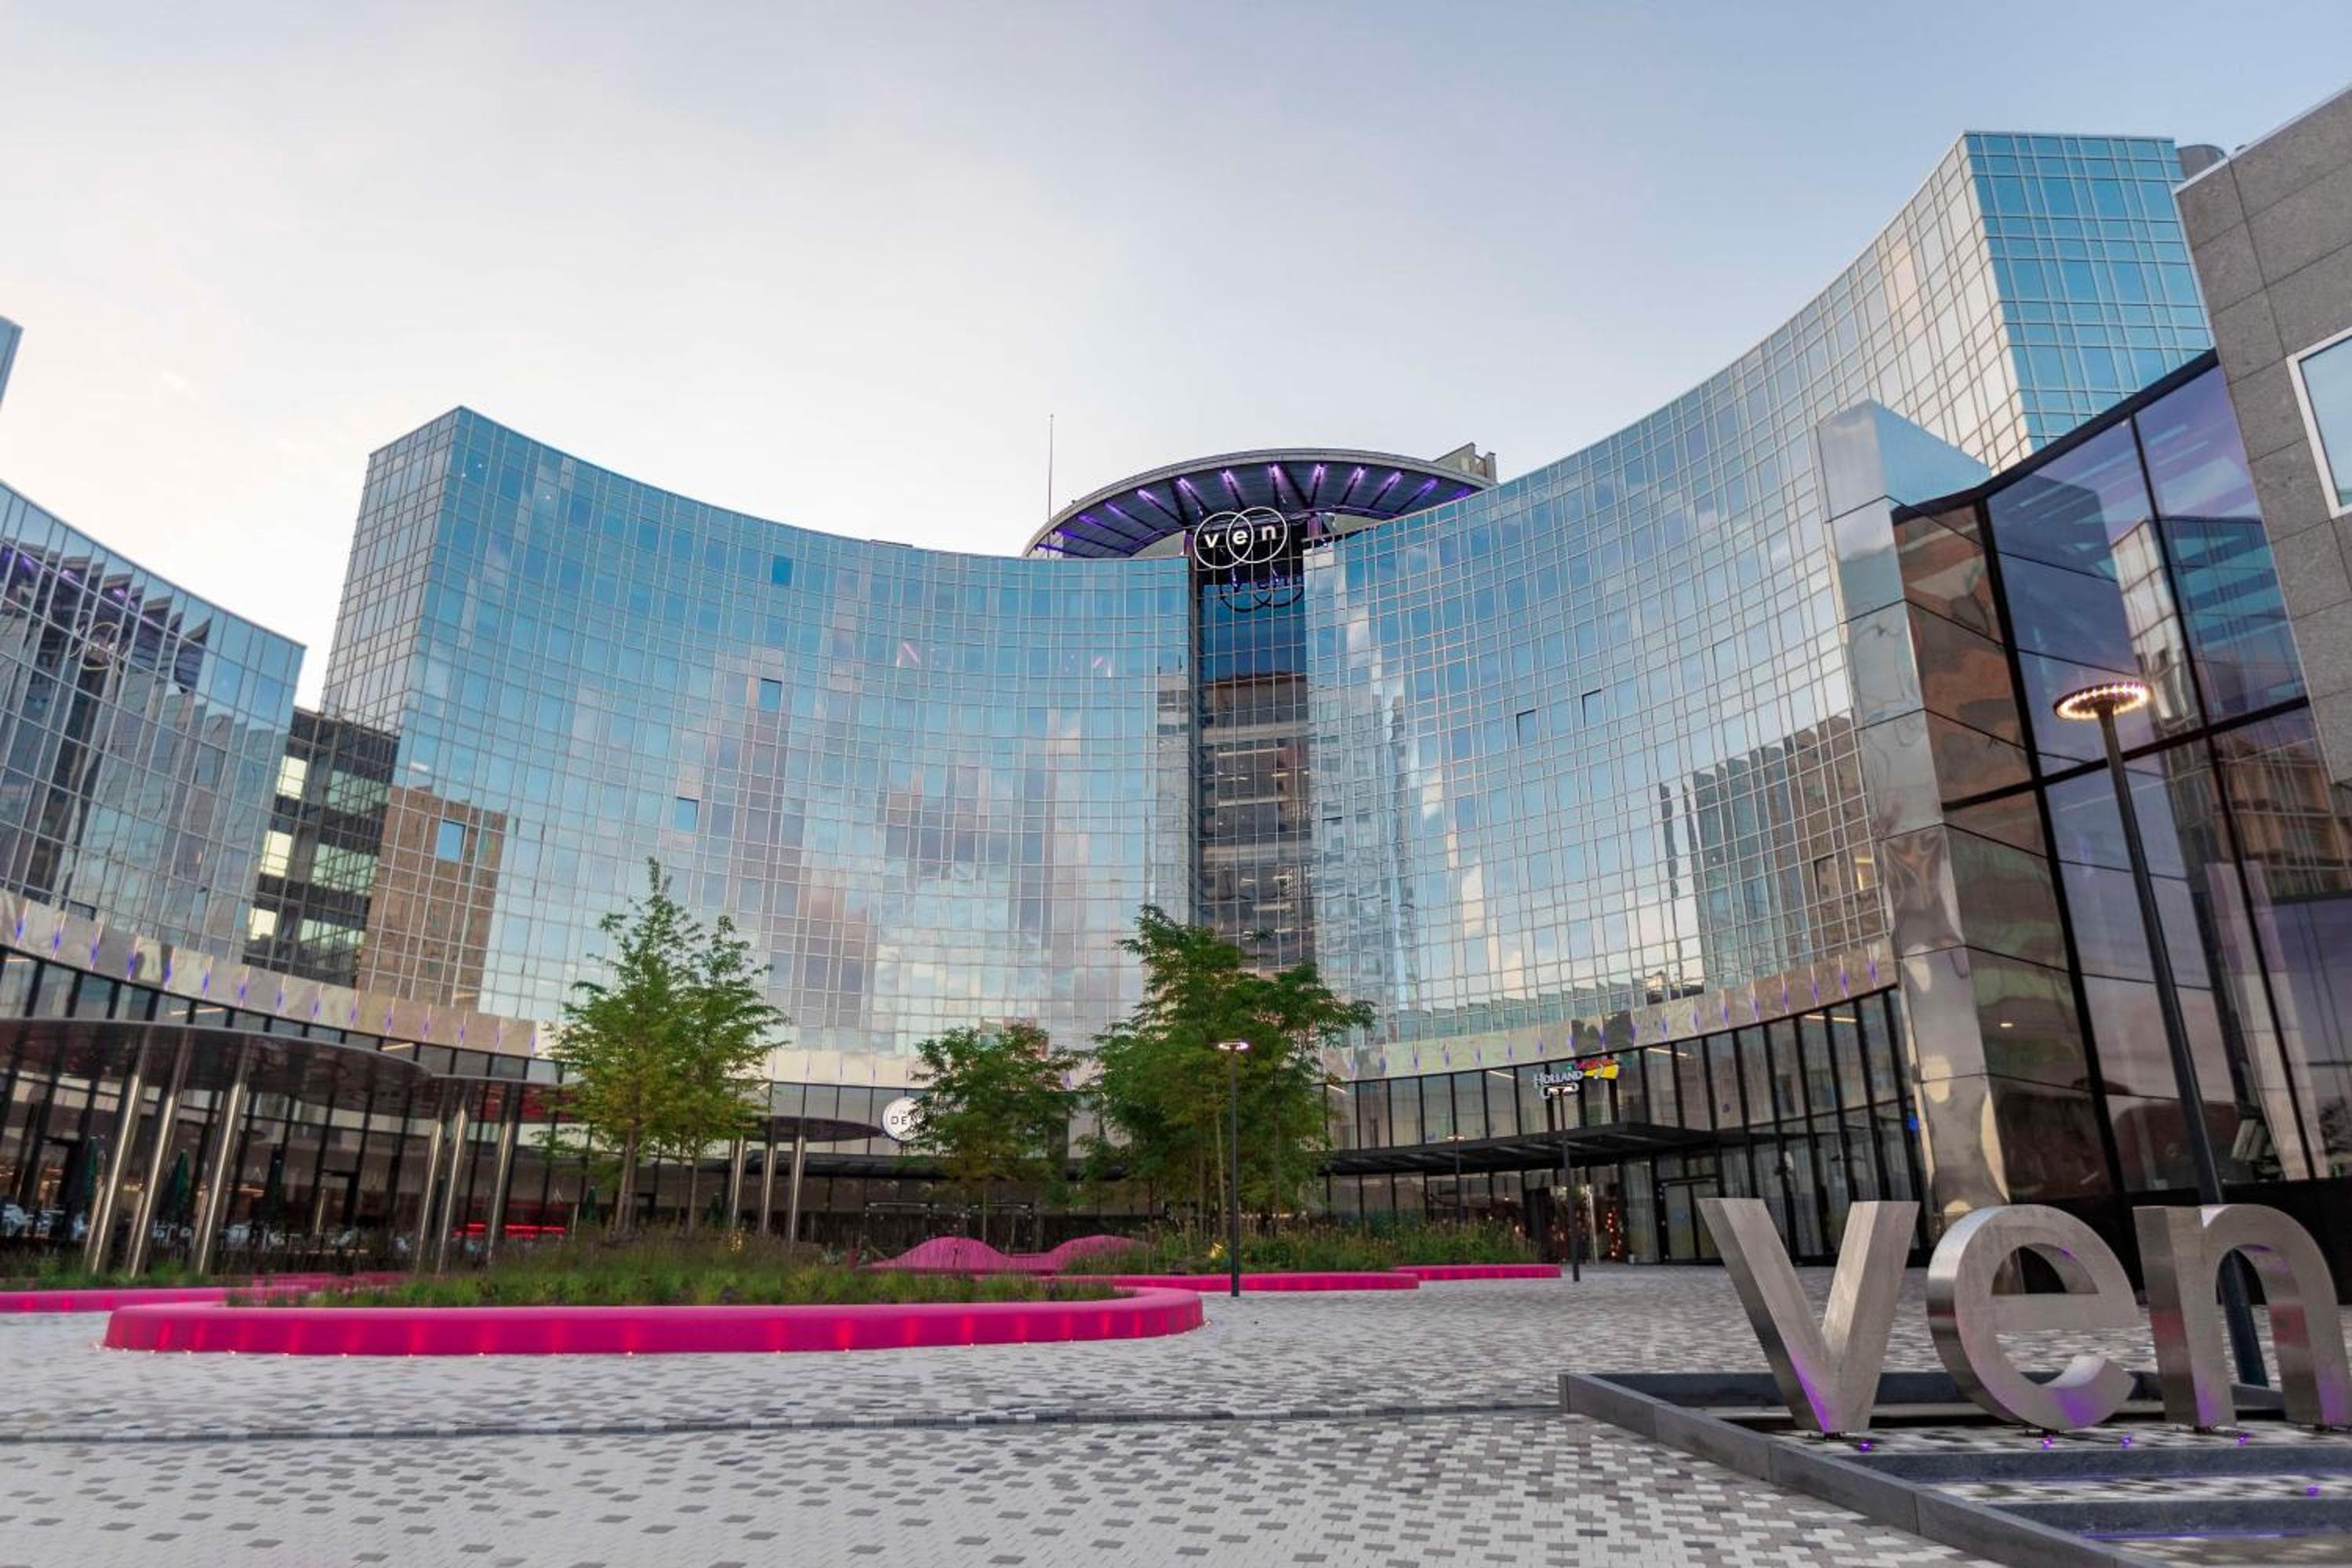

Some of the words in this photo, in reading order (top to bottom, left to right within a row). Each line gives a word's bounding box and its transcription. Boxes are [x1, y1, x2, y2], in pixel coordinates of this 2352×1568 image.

[1205, 525, 1277, 547] ven
[1533, 1070, 1583, 1087] HOLLAND
[1697, 1197, 2351, 1434] ven
